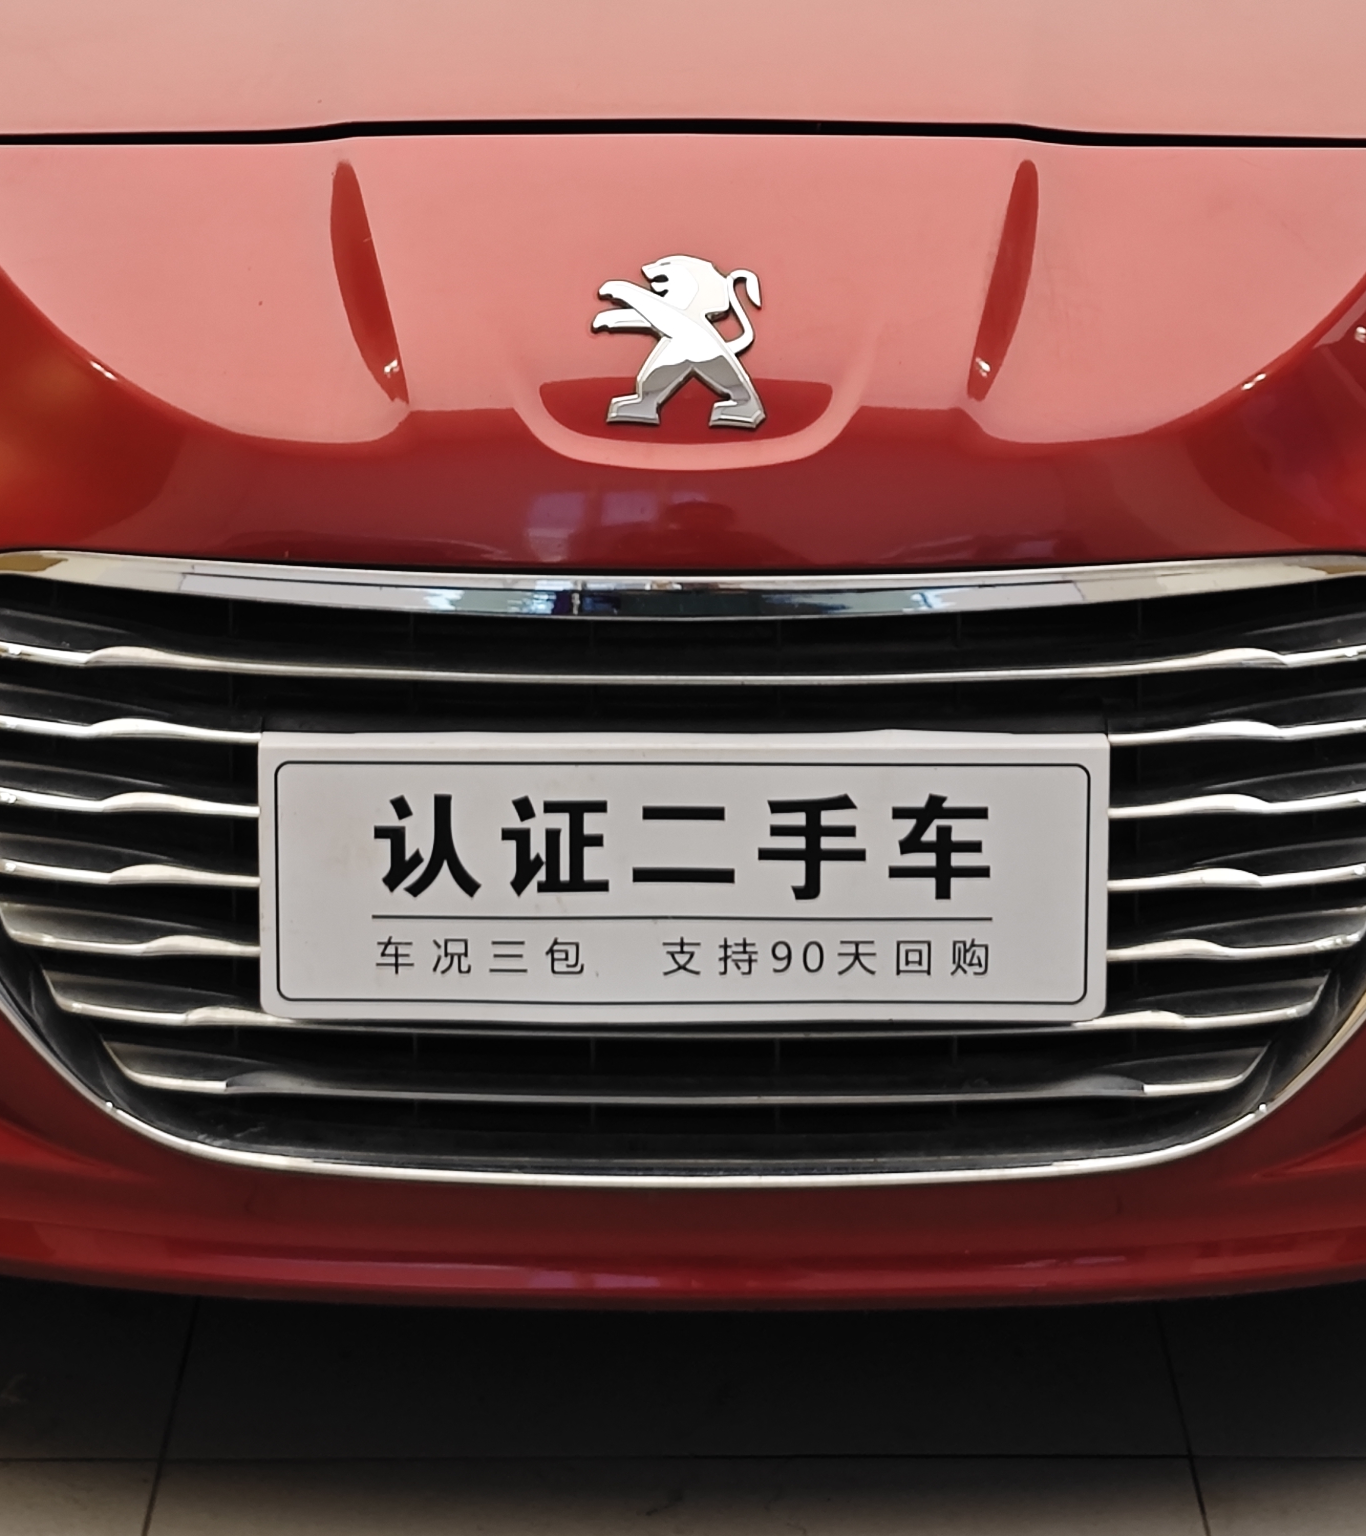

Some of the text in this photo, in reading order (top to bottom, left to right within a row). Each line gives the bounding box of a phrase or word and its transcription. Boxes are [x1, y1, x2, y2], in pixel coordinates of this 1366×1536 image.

[374, 794, 990, 900] 认证二手车
[375, 935, 989, 977] 车况三包 支持90天回购
